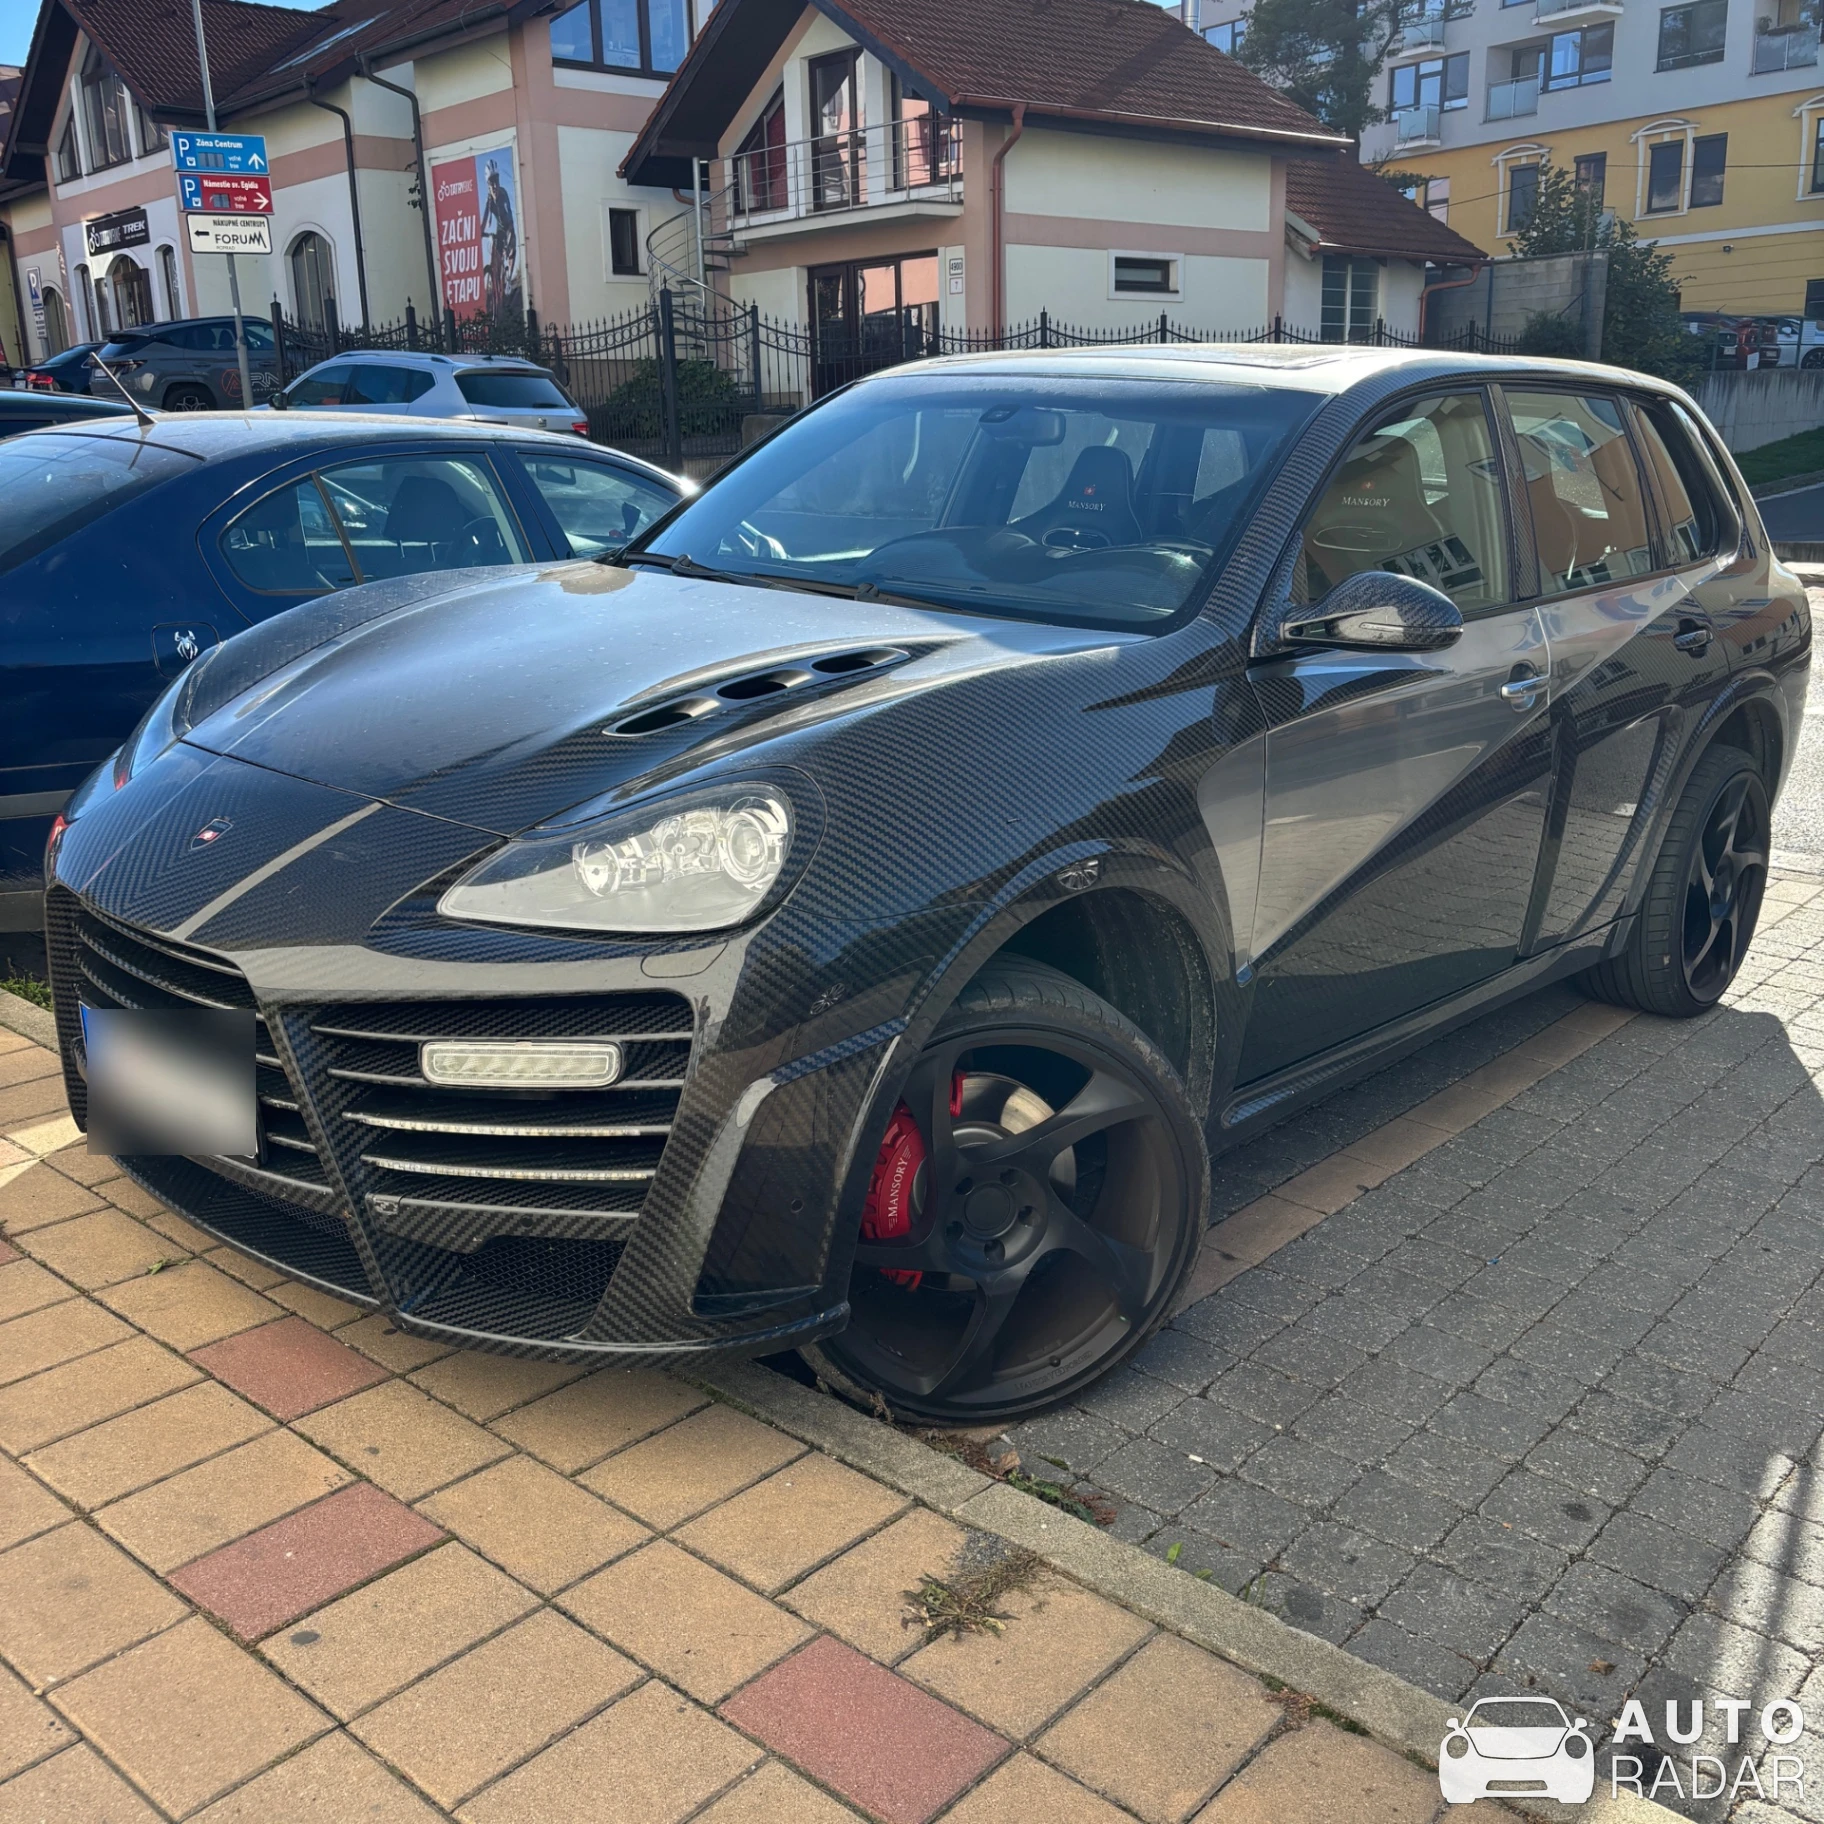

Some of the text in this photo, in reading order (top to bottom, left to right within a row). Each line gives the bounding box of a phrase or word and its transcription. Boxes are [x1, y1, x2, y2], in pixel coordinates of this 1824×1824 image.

[178, 138, 190, 158] P
[196, 138, 243, 149] Zóna Centrum
[184, 179, 196, 199] P
[203, 180, 231, 189] Námestie
[231, 181, 240, 189] sv.
[122, 220, 146, 234] TREK
[212, 217, 266, 228] NÁKUPNÉ CENTRUM
[441, 210, 477, 246] ZAČNI
[214, 230, 267, 249] FORUM
[444, 245, 479, 275] SVOJU
[446, 275, 481, 305] ETAPU
[1067, 500, 1107, 512] MANSORY
[1341, 496, 1391, 507] MANSORY
[887, 1157, 908, 1218] MANSORY
